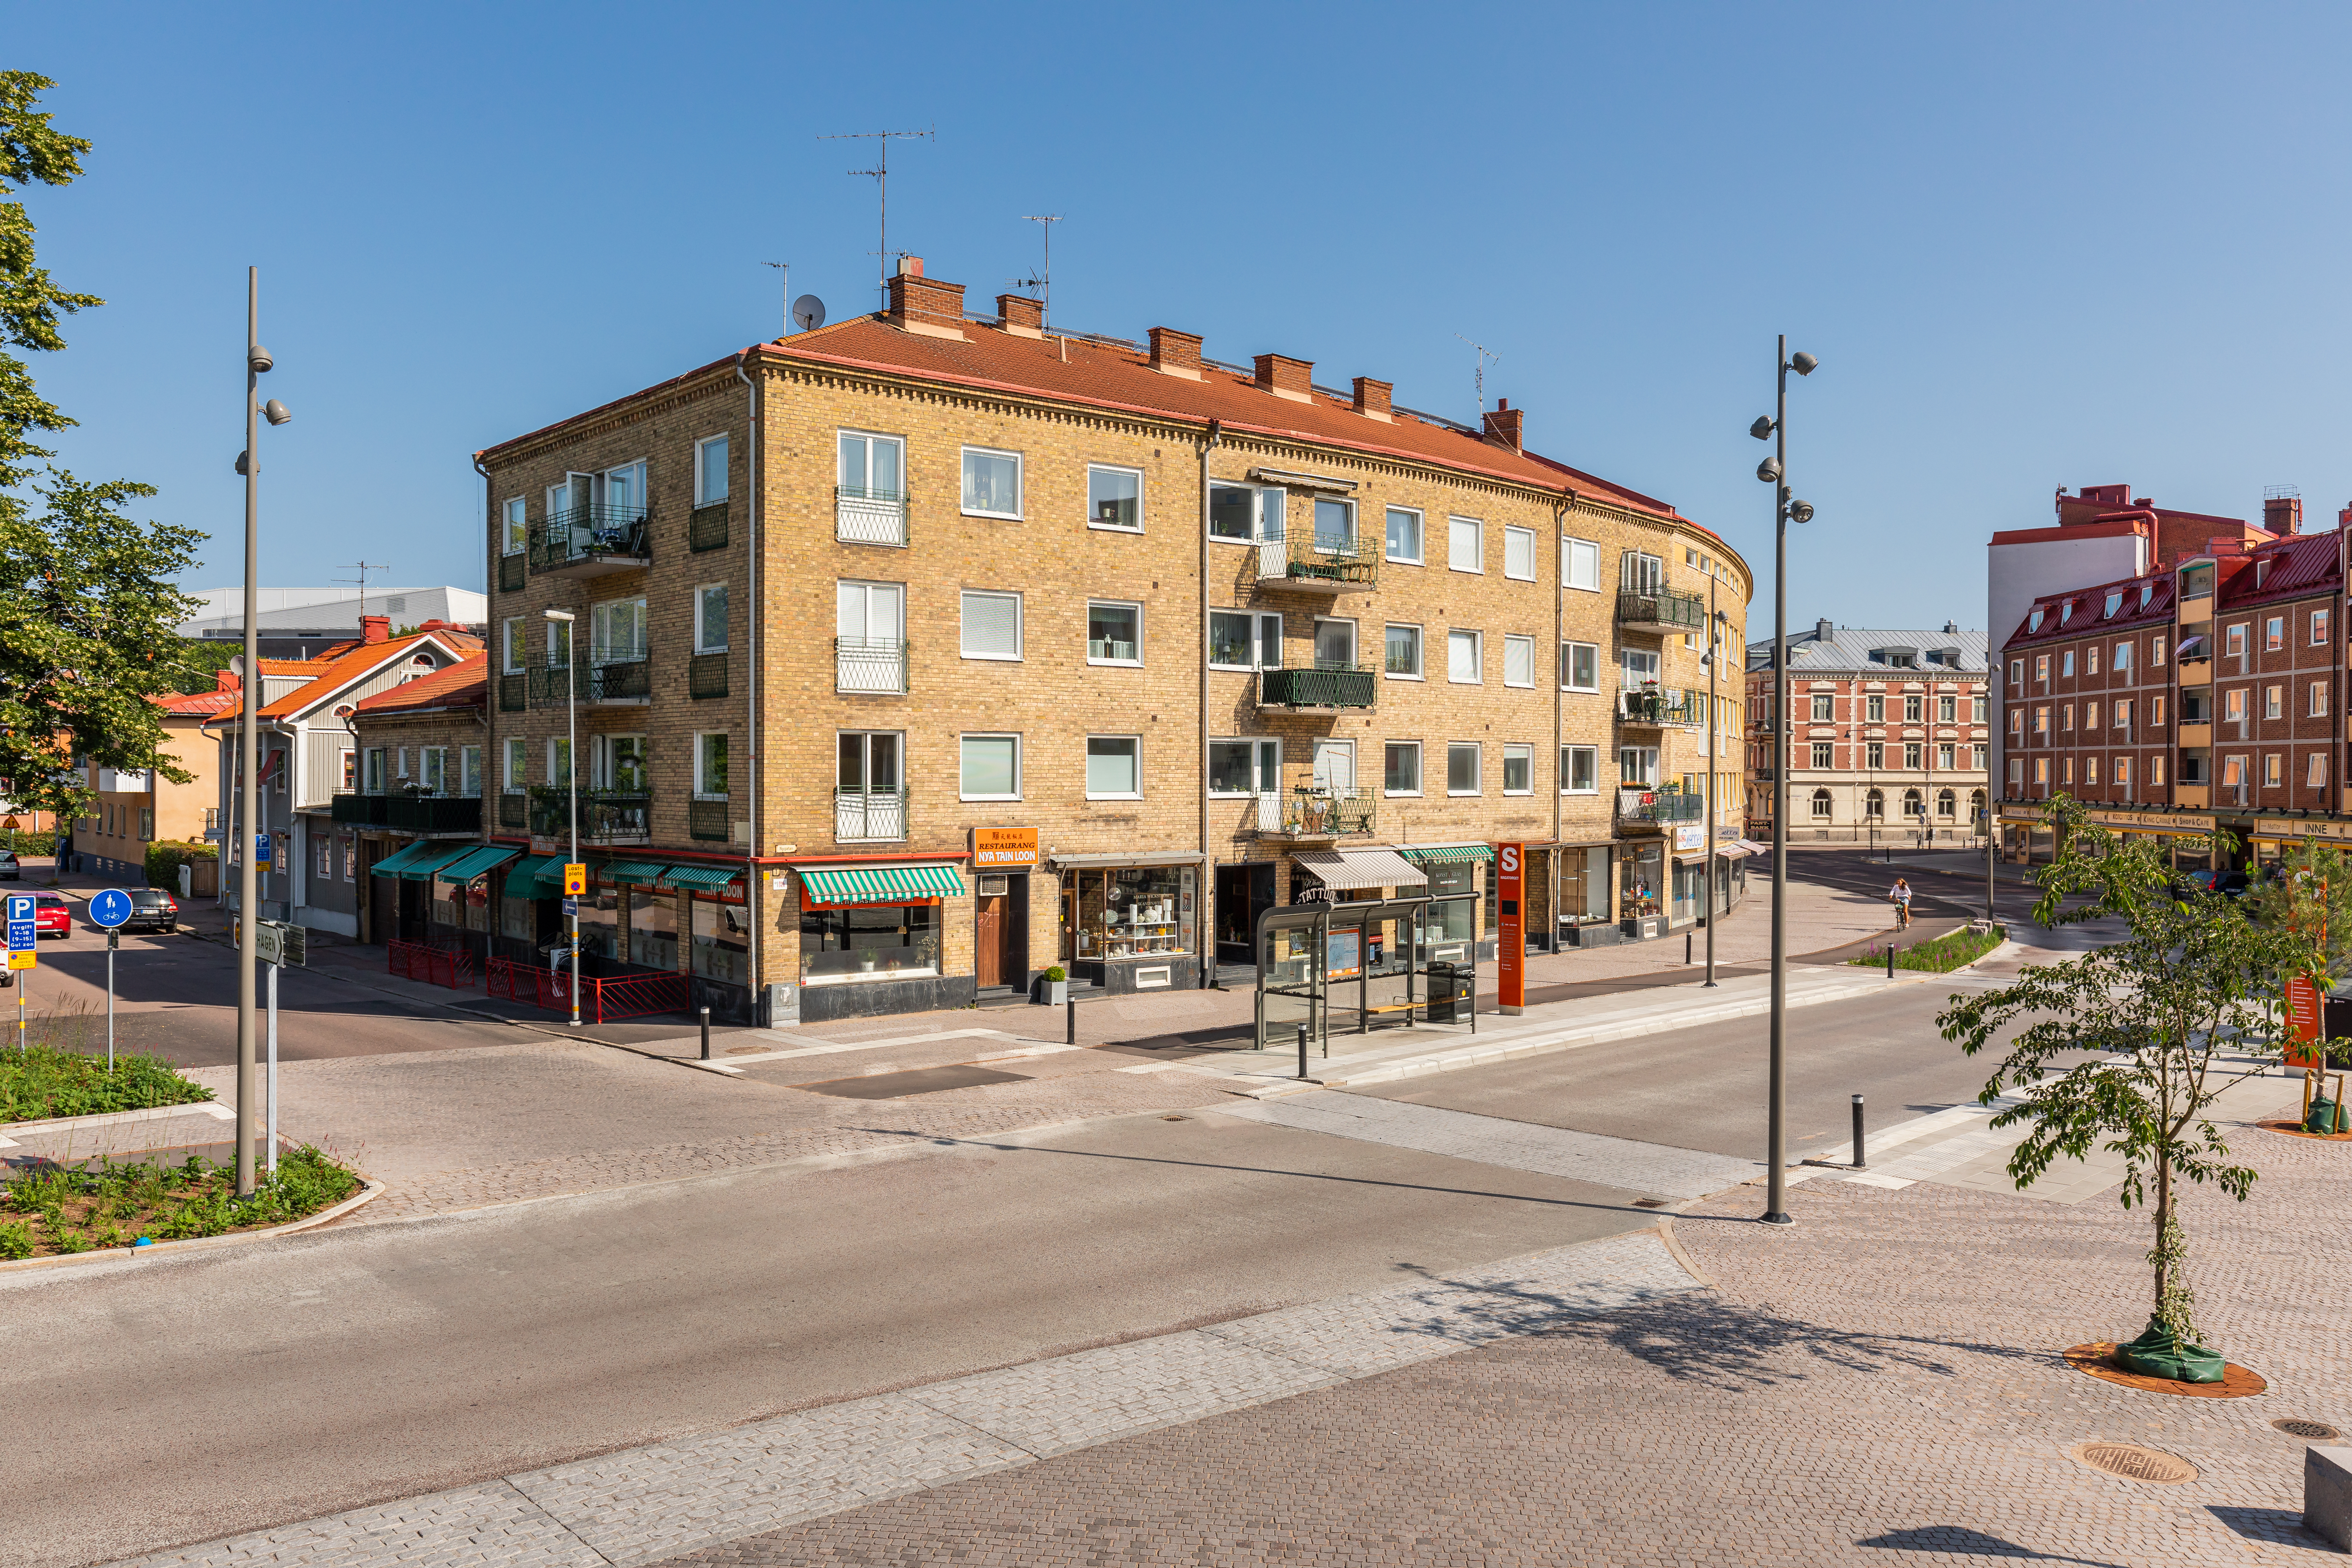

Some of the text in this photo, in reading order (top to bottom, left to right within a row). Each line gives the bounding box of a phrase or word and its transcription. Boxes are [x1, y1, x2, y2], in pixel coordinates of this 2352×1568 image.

[2305, 823, 2327, 834] INNE
[260, 836, 267, 846] P
[546, 843, 555, 852] LOON
[978, 851, 1035, 862] NYA TAIN LOON
[1501, 847, 1518, 871] S
[1304, 879, 1322, 888] What
[722, 885, 742, 898] OON
[1299, 887, 1336, 903] TATTOO
[15, 899, 30, 918] P
[256, 933, 276, 953] HAGEN
